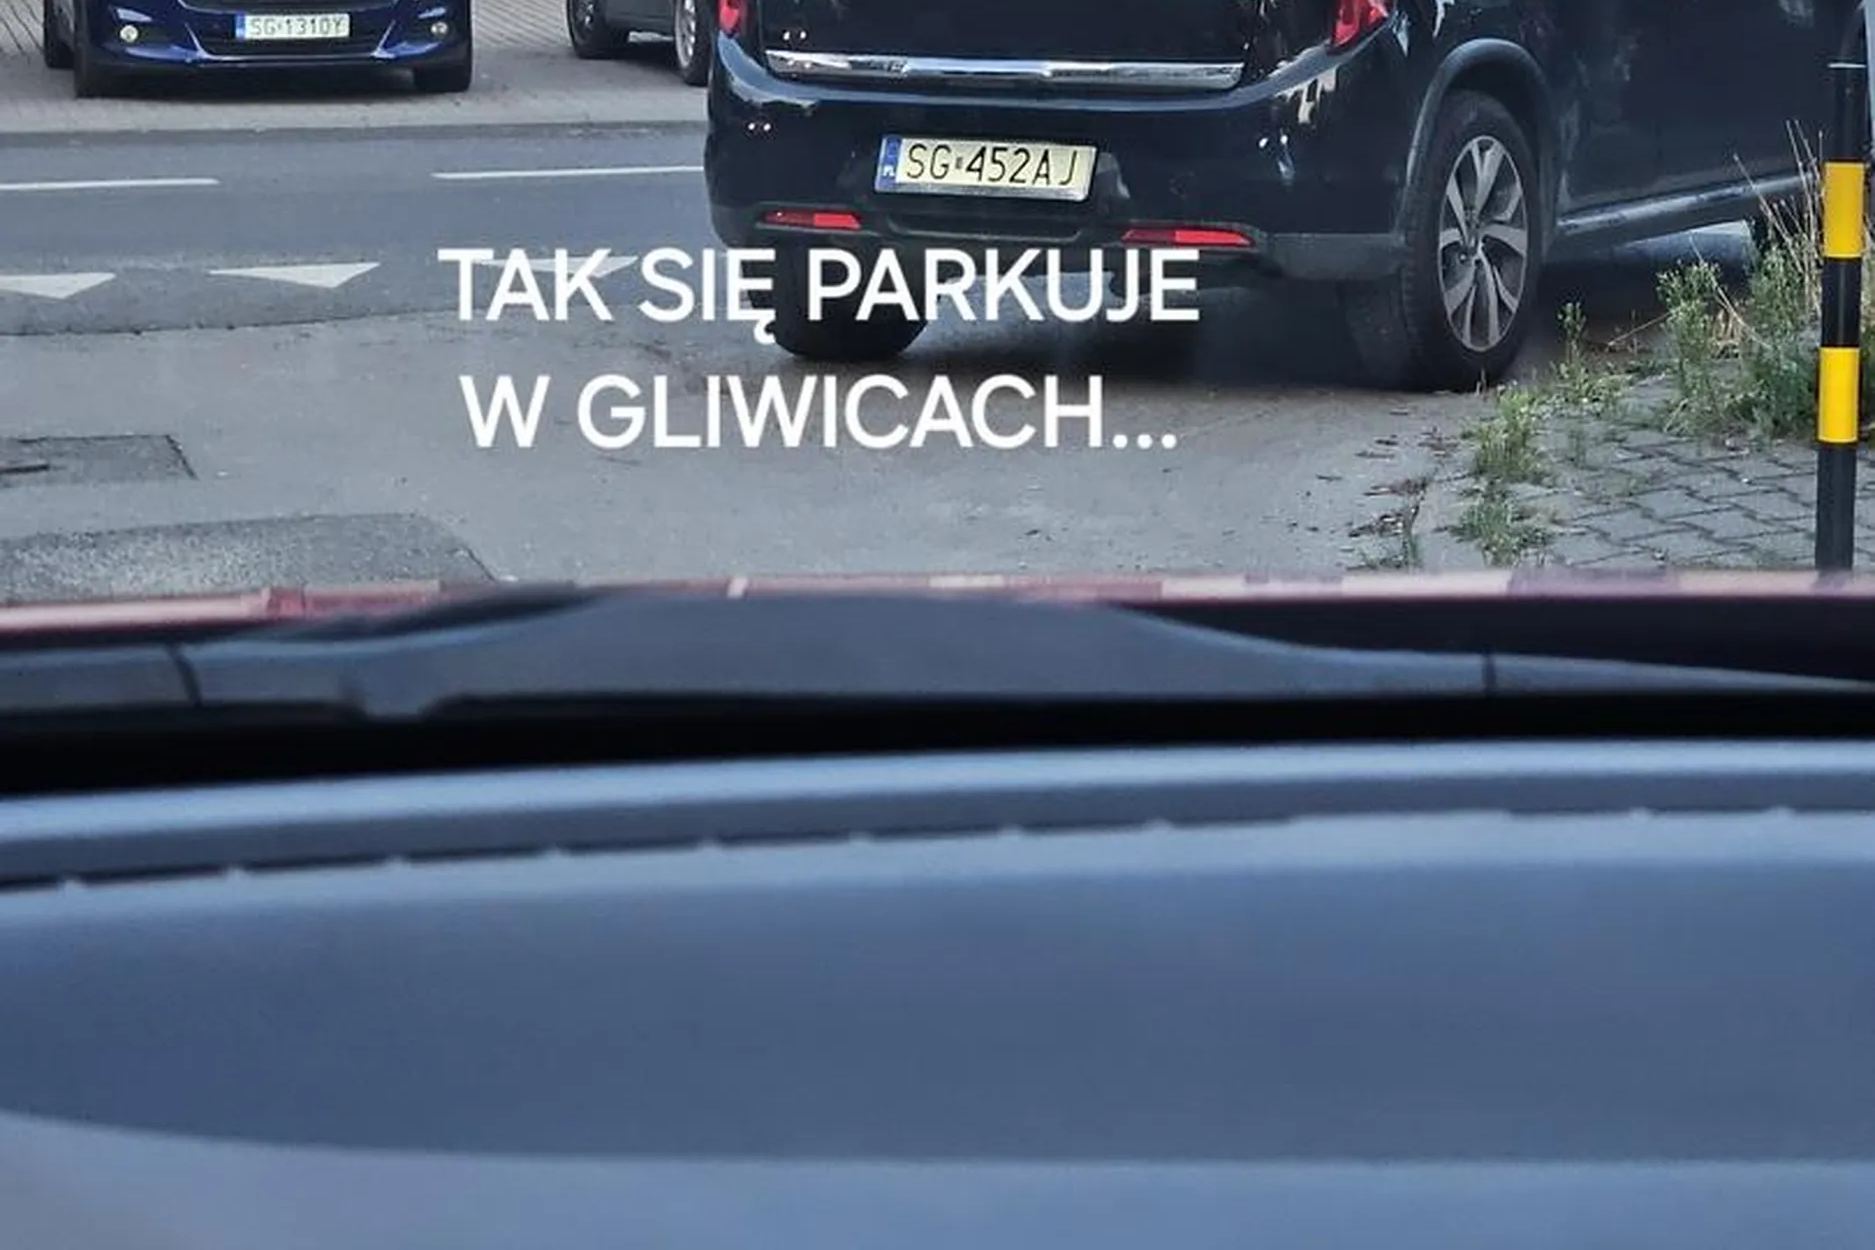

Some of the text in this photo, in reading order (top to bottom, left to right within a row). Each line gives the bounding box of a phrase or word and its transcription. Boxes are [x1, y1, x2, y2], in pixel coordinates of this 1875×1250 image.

[250, 17, 276, 36] SG
[906, 143, 1078, 187] SG 452AJ
